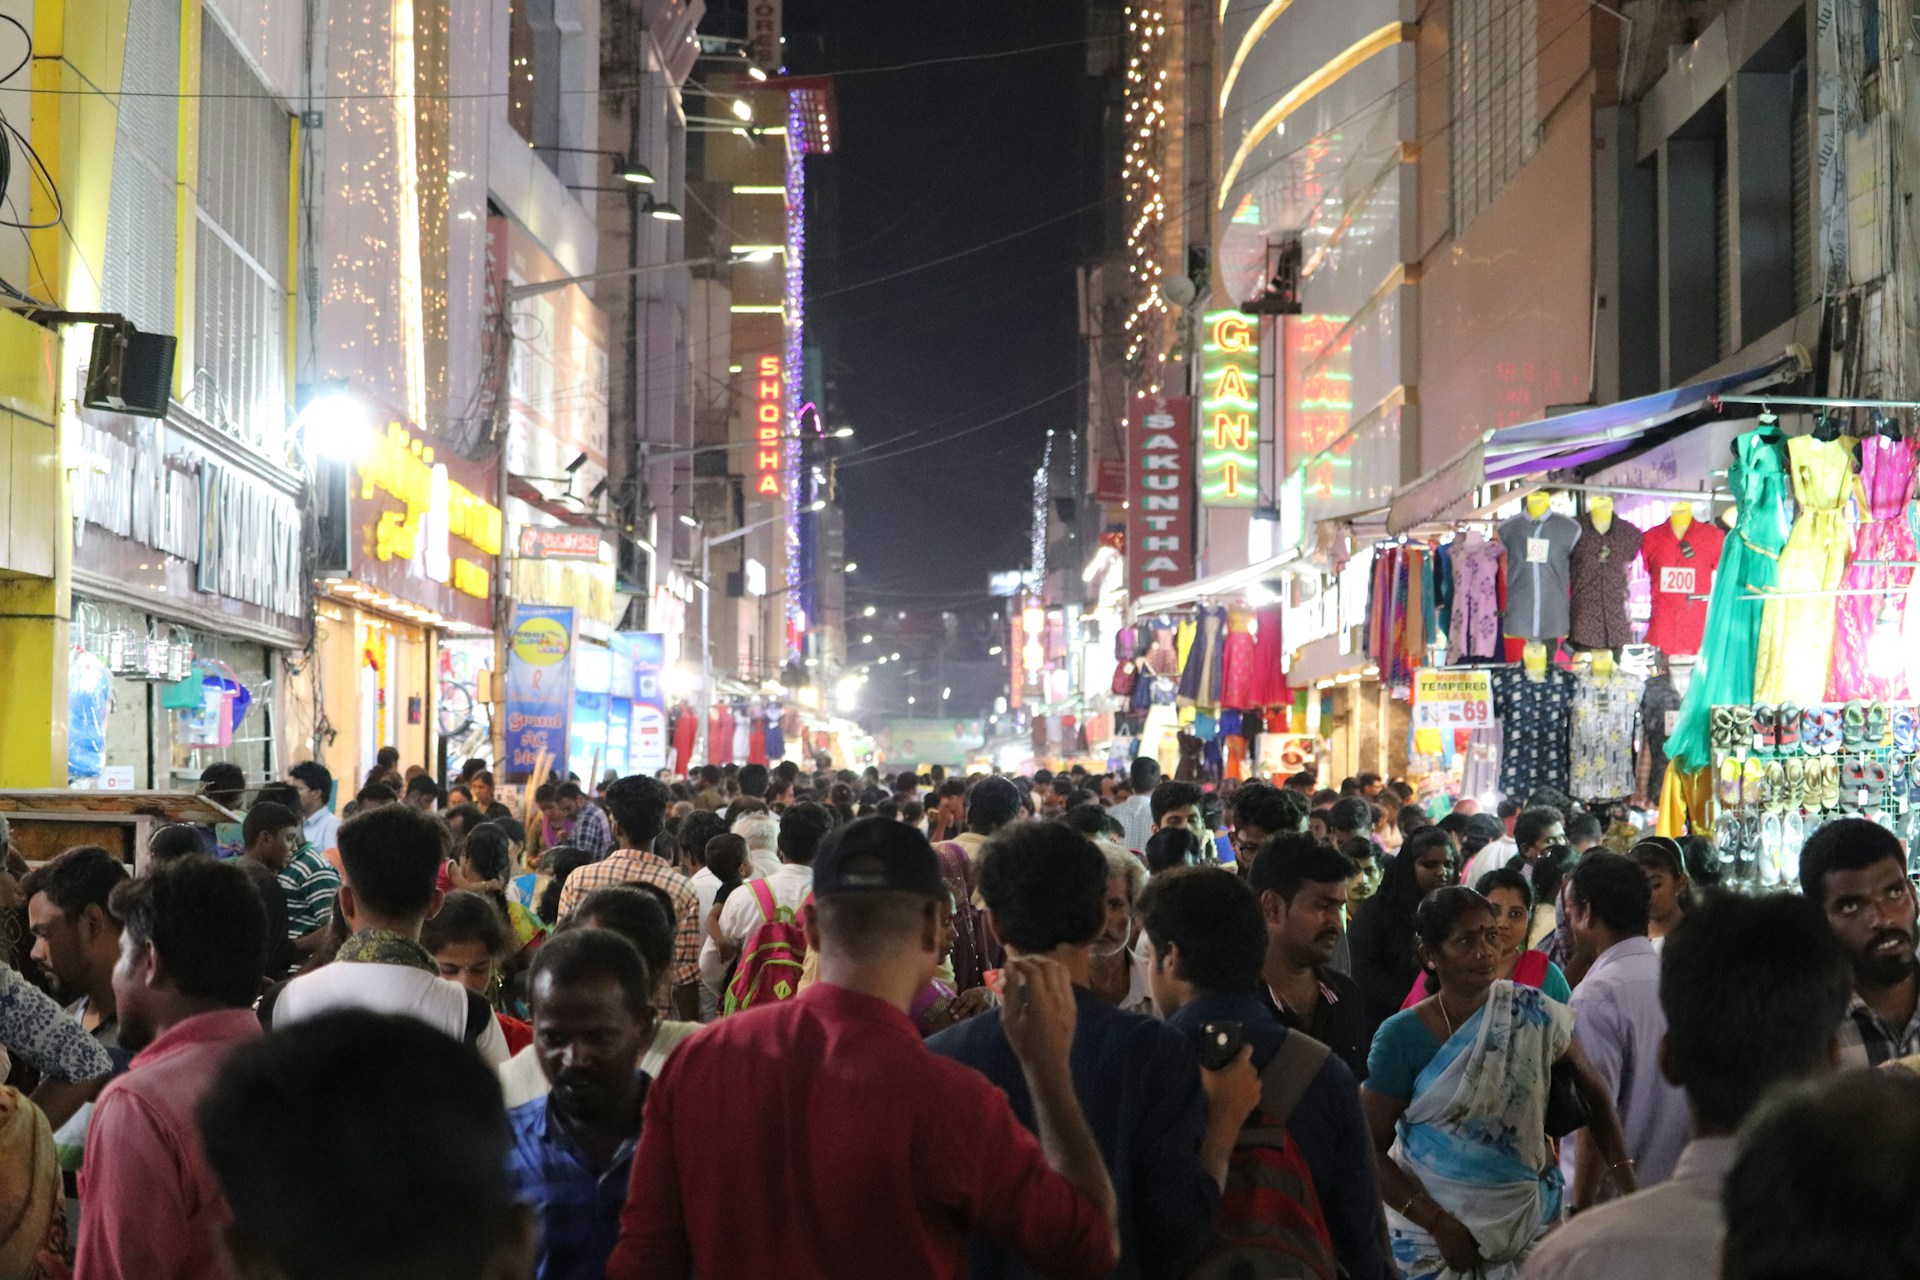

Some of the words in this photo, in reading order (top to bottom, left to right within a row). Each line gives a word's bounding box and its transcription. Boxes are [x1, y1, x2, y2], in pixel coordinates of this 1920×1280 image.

[1213, 319, 1251, 497] GANI
[758, 355, 781, 494] SHOBHA
[1667, 571, 1693, 590] 200
[1421, 682, 1487, 691] TEMPERED
[1463, 700, 1488, 721] 69
[509, 712, 562, 731] Grand
